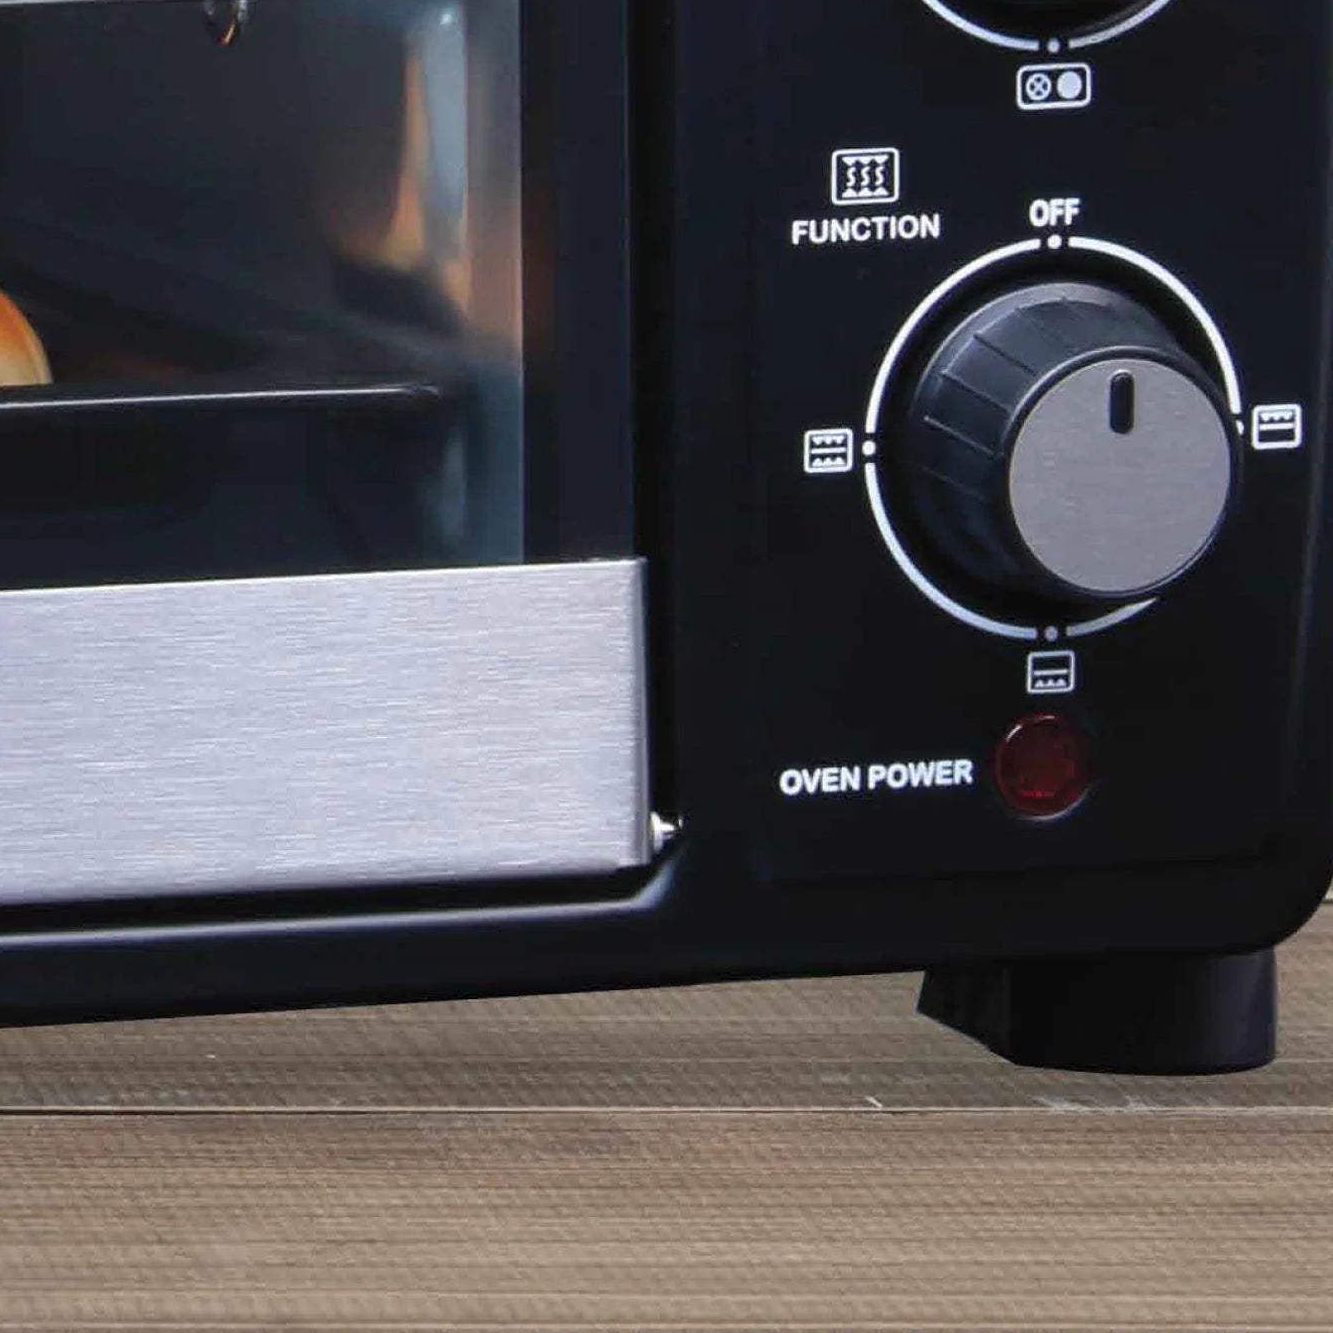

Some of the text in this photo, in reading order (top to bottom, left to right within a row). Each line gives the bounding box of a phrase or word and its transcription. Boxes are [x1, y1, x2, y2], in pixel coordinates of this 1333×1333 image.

[1028, 197, 1080, 228] OFF
[791, 213, 941, 245] FUNCTION
[779, 759, 973, 796] OVEN POWER
